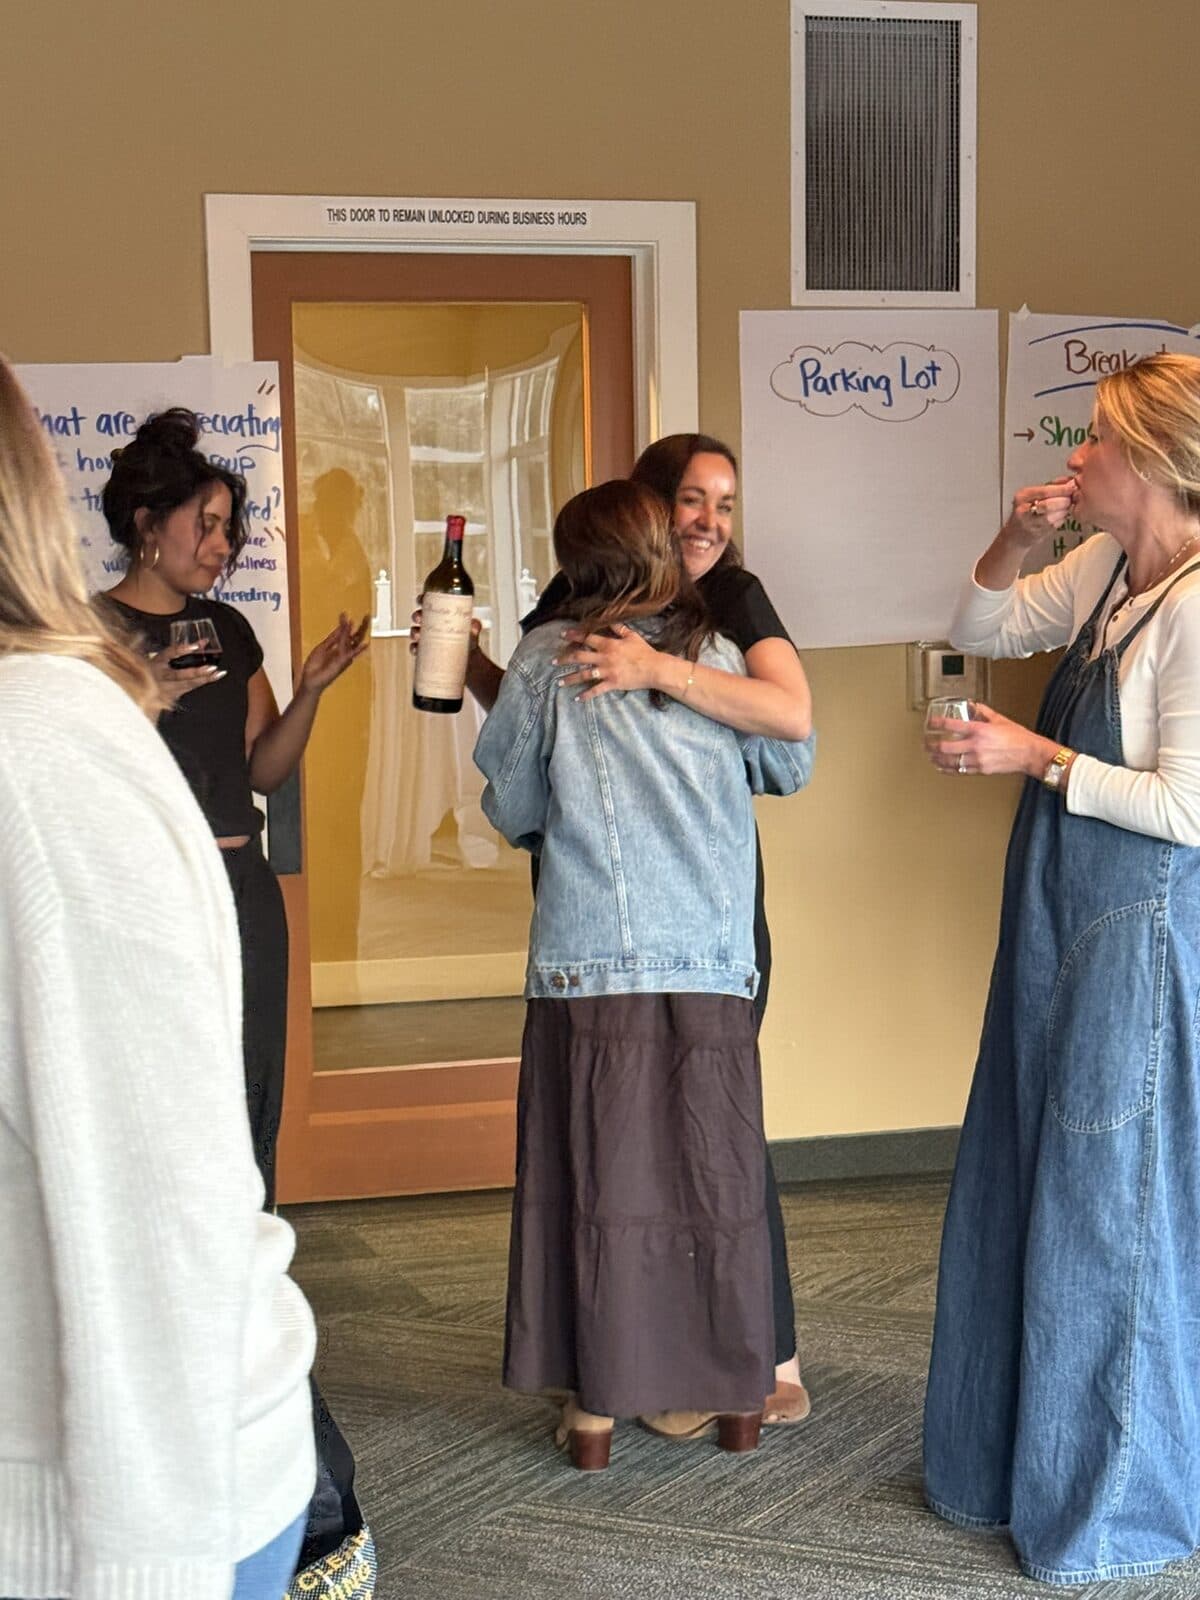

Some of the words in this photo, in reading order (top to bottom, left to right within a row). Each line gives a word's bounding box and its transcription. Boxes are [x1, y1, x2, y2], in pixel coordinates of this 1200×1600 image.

[326, 208, 347, 222] THIS
[349, 208, 376, 222] DOOR
[378, 208, 391, 222] TO
[392, 209, 426, 223] REMAIN
[428, 209, 475, 224] UNLOCKED
[477, 210, 510, 224] DURING
[512, 211, 556, 225] BUSINESS
[557, 211, 588, 226] HOURS
[799, 357, 893, 407] Parking
[900, 355, 942, 390] Lot
[36, 406, 87, 437] hat
[96, 411, 138, 437] are
